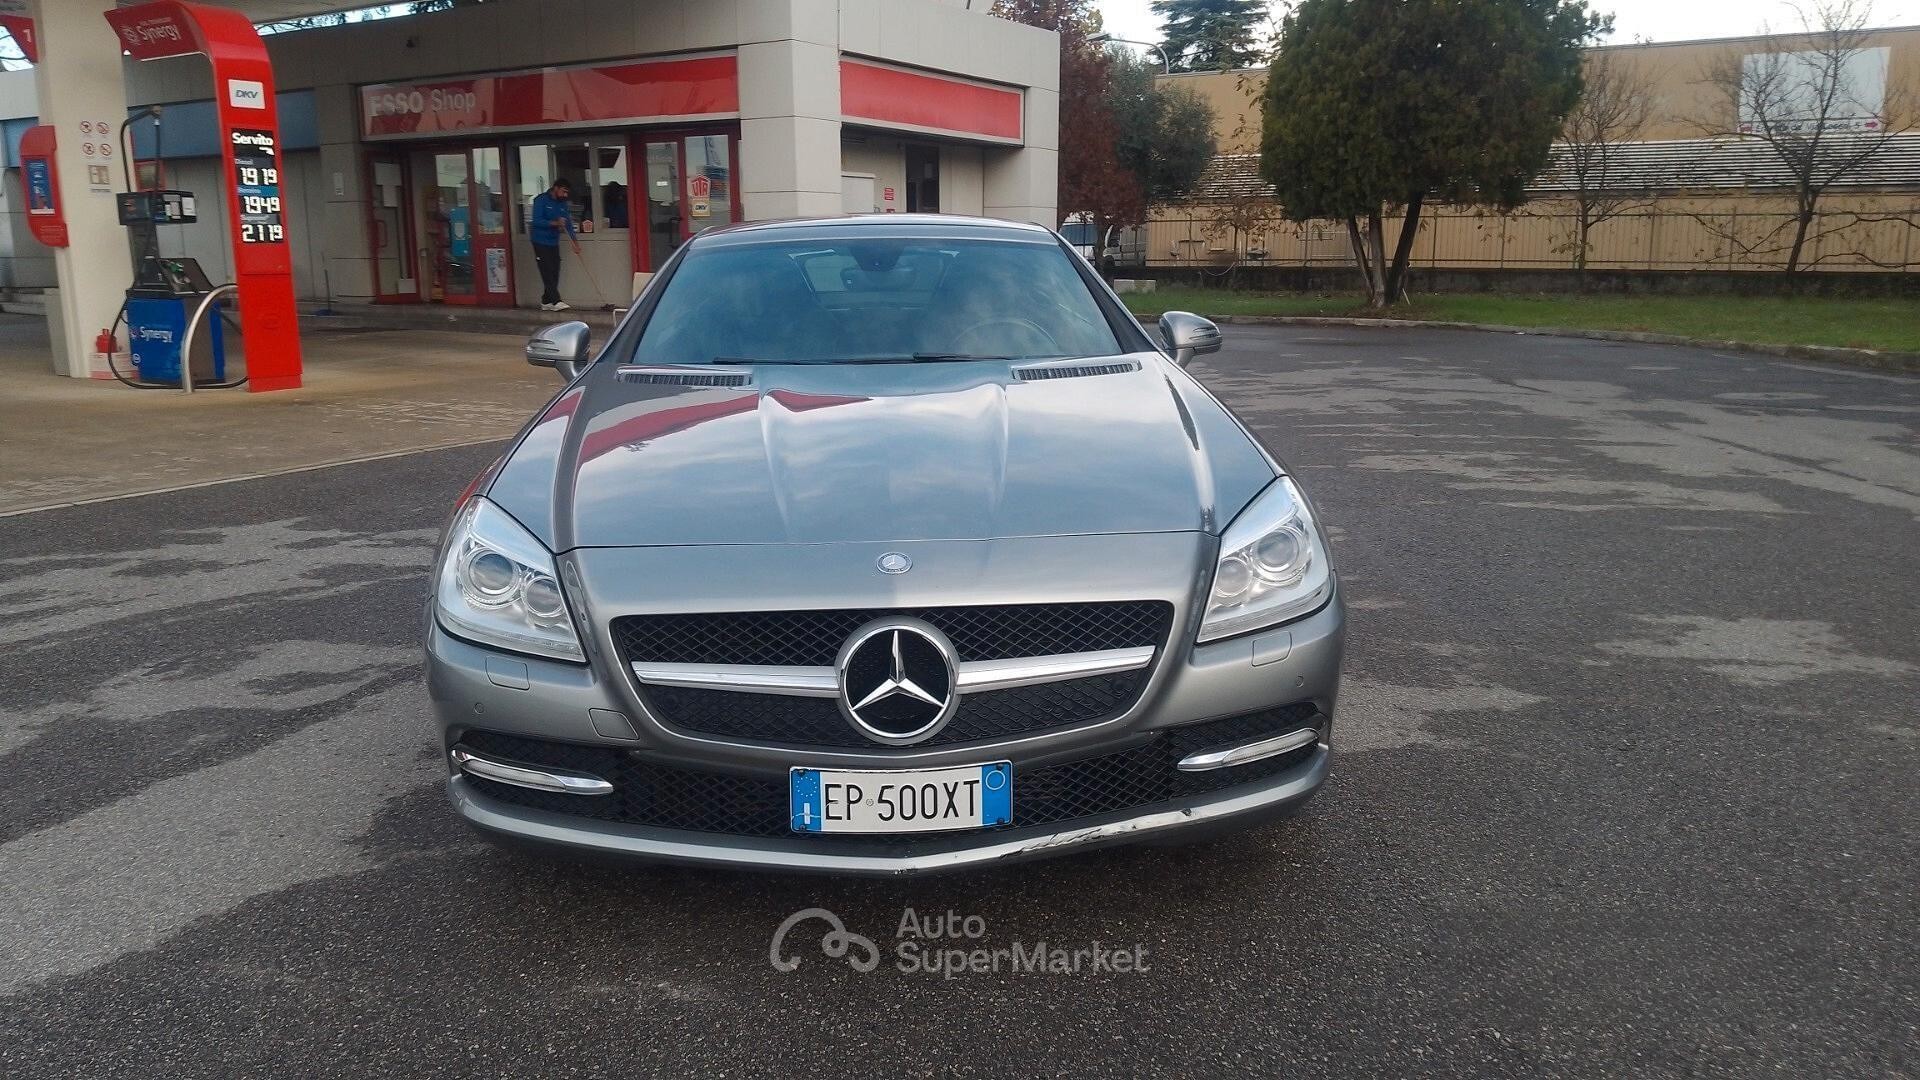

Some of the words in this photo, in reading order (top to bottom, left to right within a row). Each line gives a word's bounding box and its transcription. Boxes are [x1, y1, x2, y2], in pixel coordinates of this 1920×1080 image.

[136, 24, 181, 44] Synergy
[235, 89, 259, 99] DKV
[431, 88, 476, 113] Shop
[231, 131, 274, 147] Servito
[139, 326, 173, 343] Synergy
[824, 782, 864, 822] EP
[876, 779, 980, 822] 500XT
